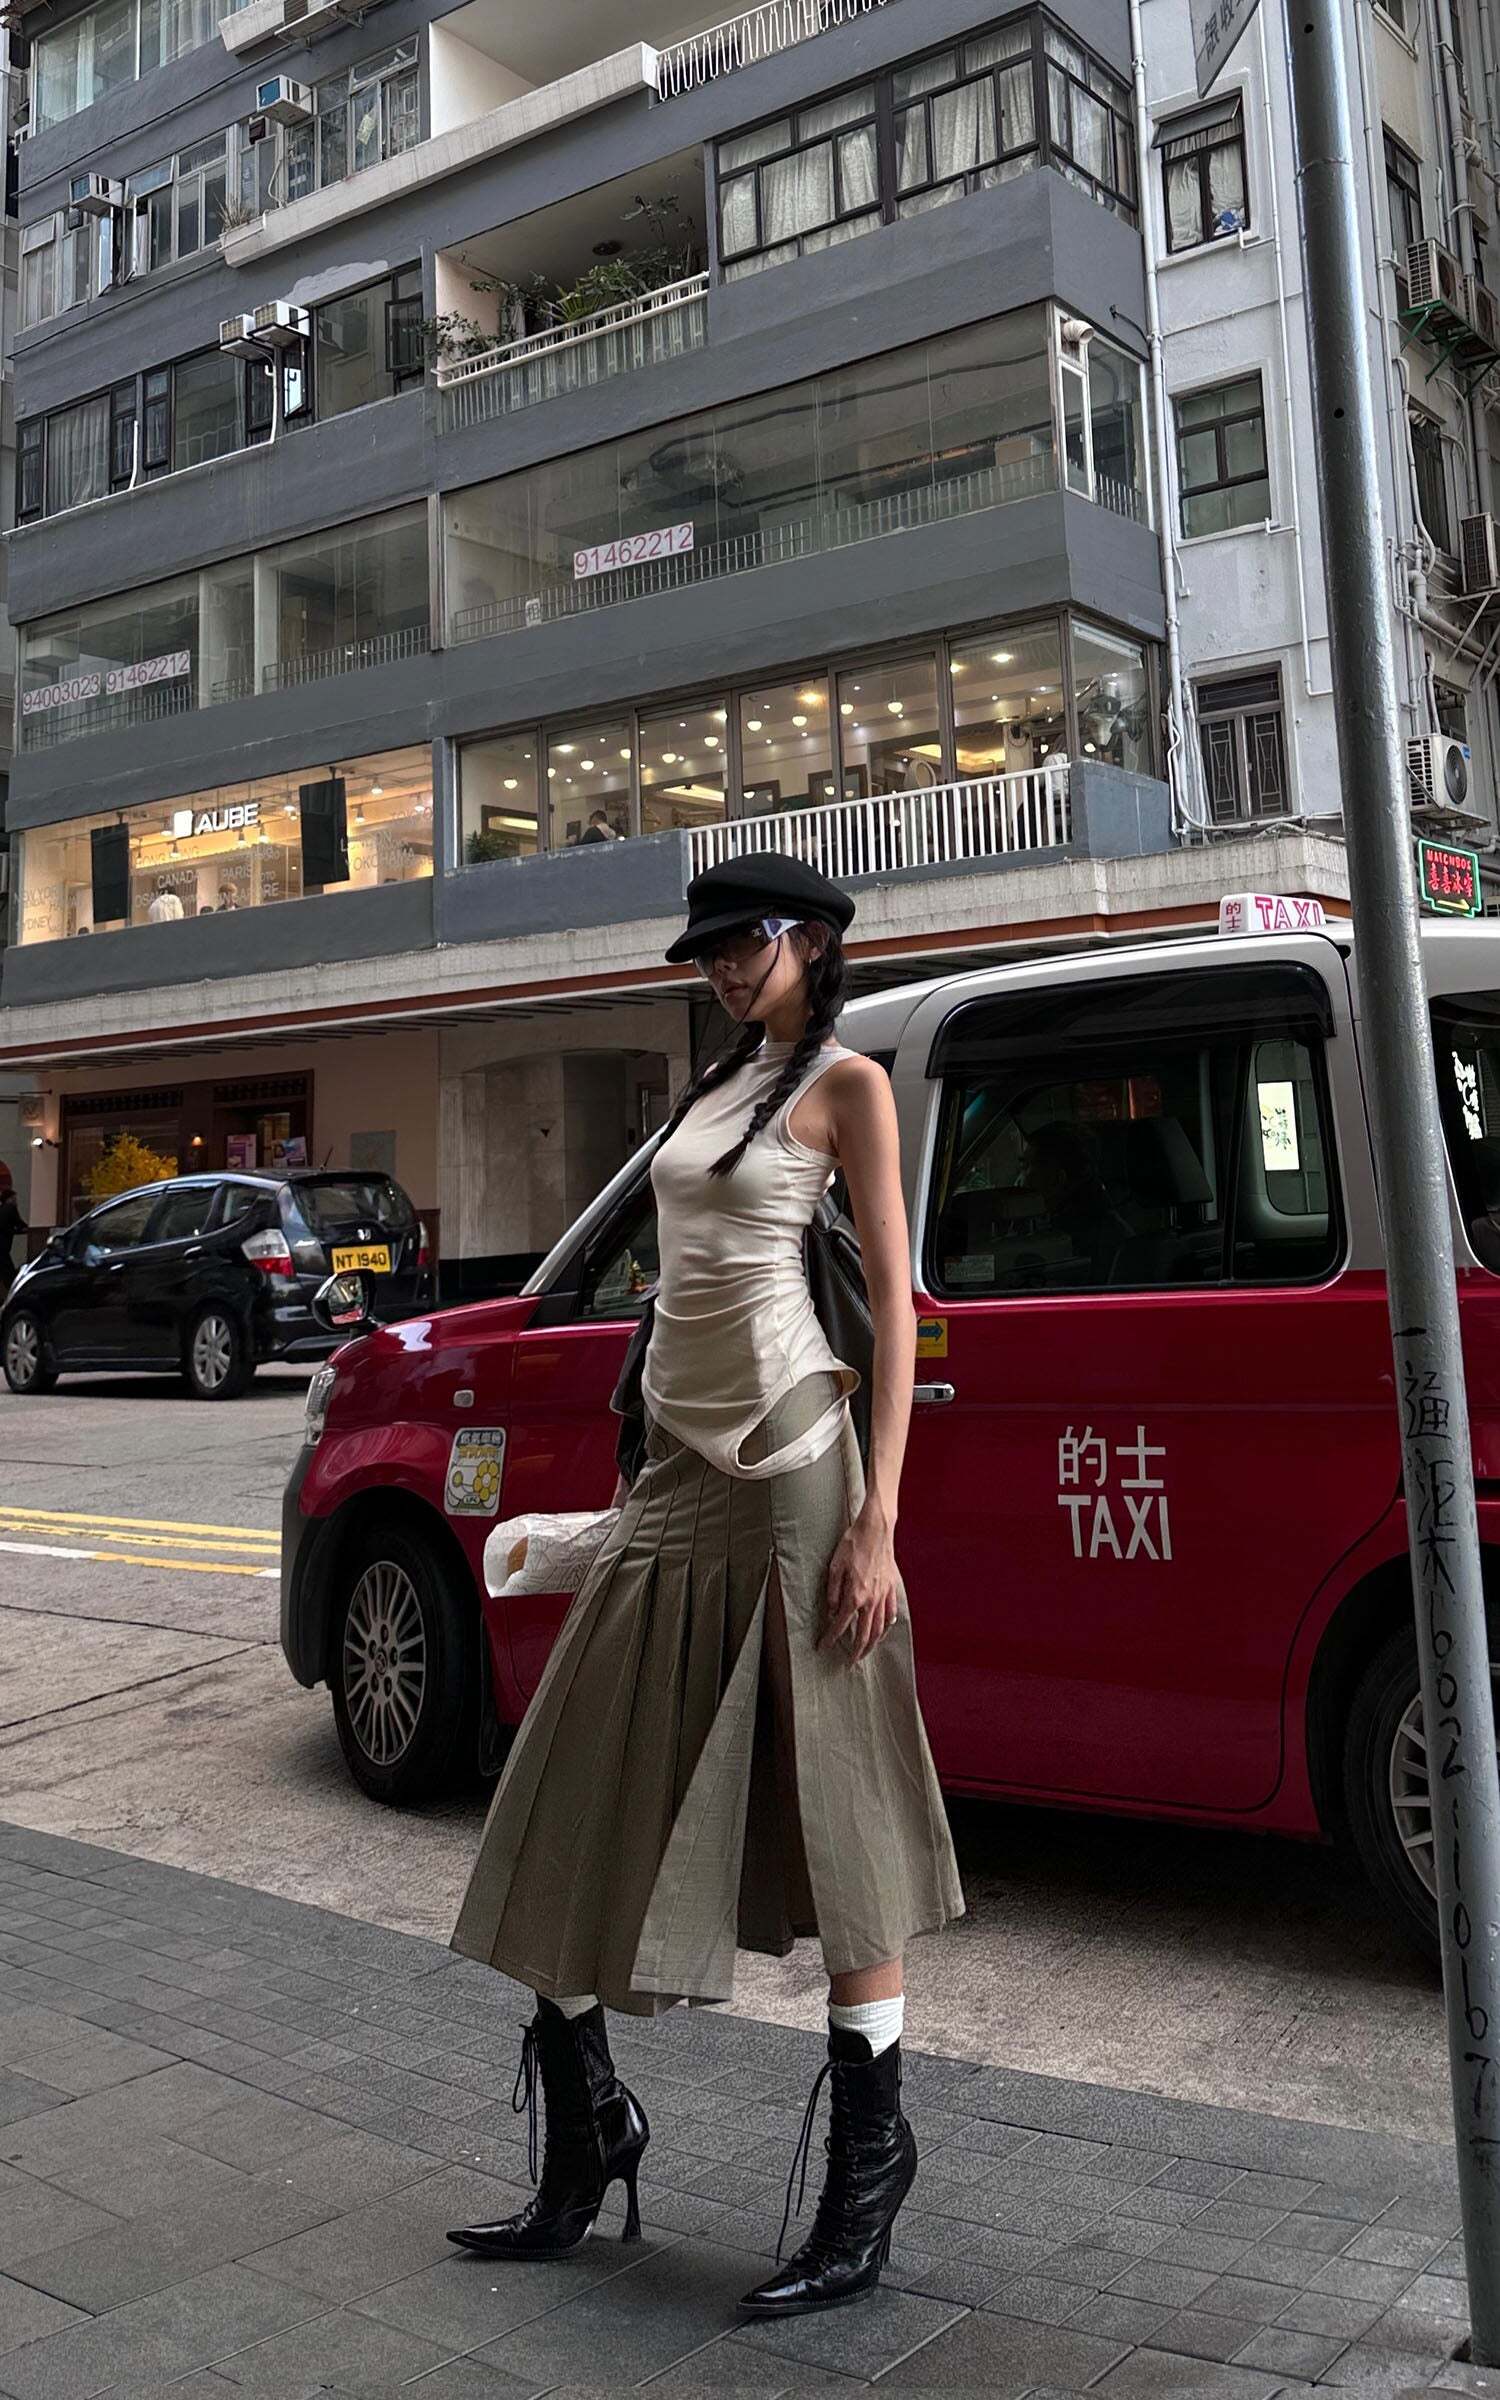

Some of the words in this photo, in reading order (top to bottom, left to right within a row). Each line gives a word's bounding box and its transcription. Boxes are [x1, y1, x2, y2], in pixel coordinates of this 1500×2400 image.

[575, 524, 692, 575] 91462212
[23, 674, 100, 712] 94003023
[107, 651, 190, 692] 91462212
[194, 803, 260, 835] AUBE
[1225, 902, 1242, 929] 的士
[1255, 895, 1321, 930] TAXI
[335, 1254, 354, 1269] NT
[357, 1252, 387, 1267] 1940
[1058, 1425, 1166, 1488] 的士
[1058, 1494, 1173, 1560] TAXI
